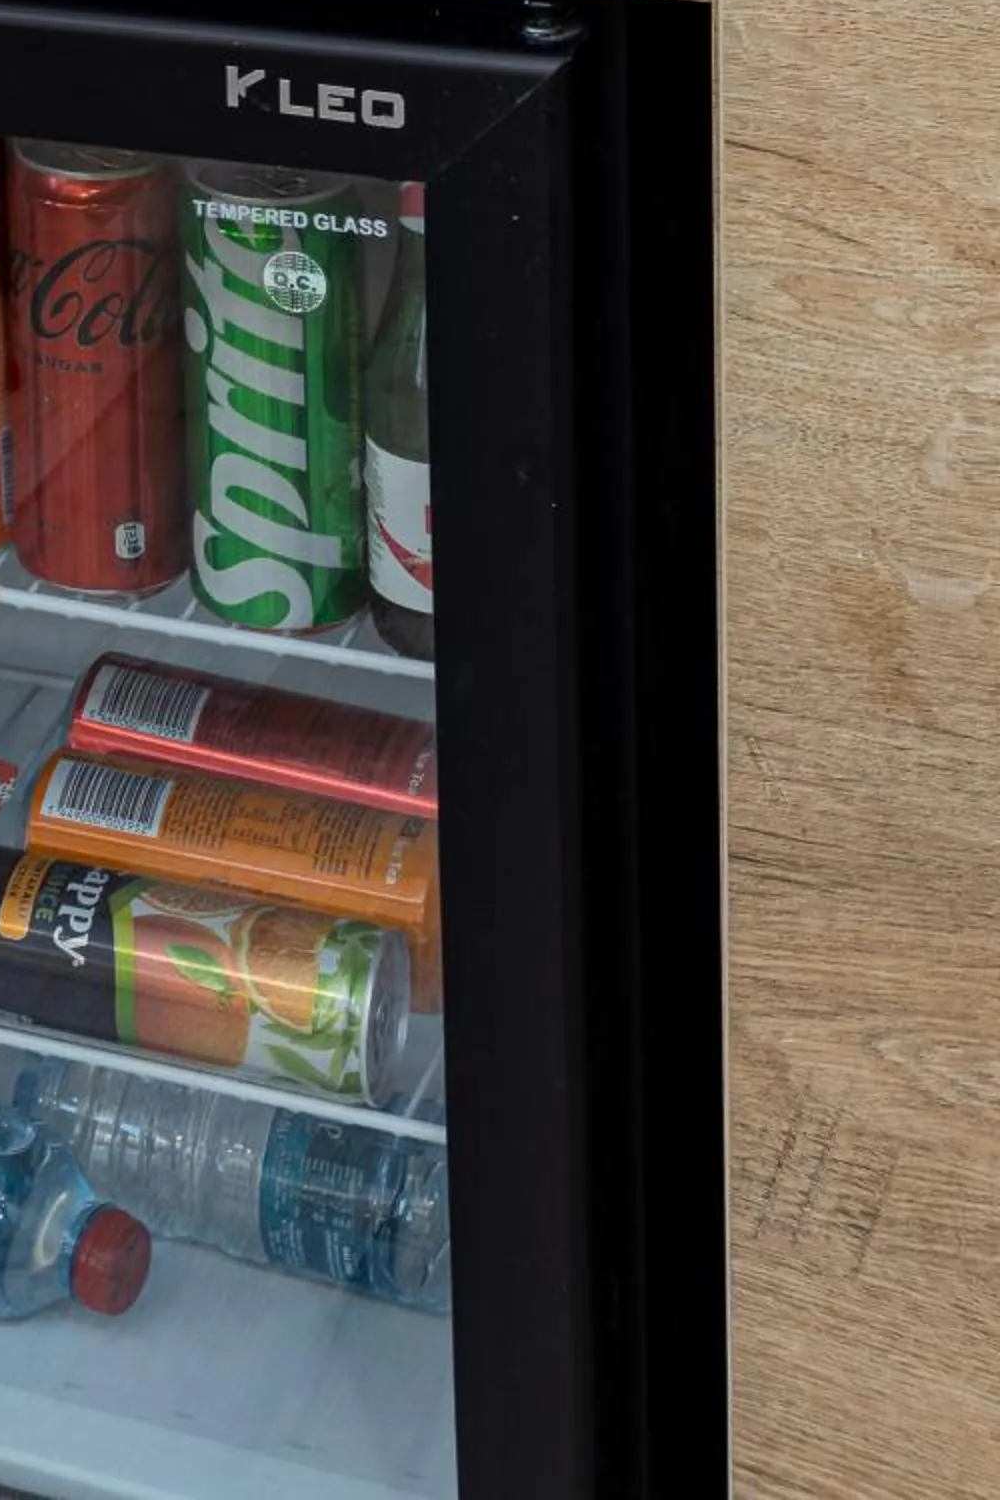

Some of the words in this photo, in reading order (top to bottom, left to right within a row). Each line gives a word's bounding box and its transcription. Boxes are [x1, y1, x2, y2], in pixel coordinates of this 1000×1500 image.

[224, 64, 406, 129] KLEO
[192, 198, 308, 230] TEMPERED
[313, 211, 388, 238] GLASS
[185, 212, 342, 630] Sprite
[52, 868, 110, 963] appy
